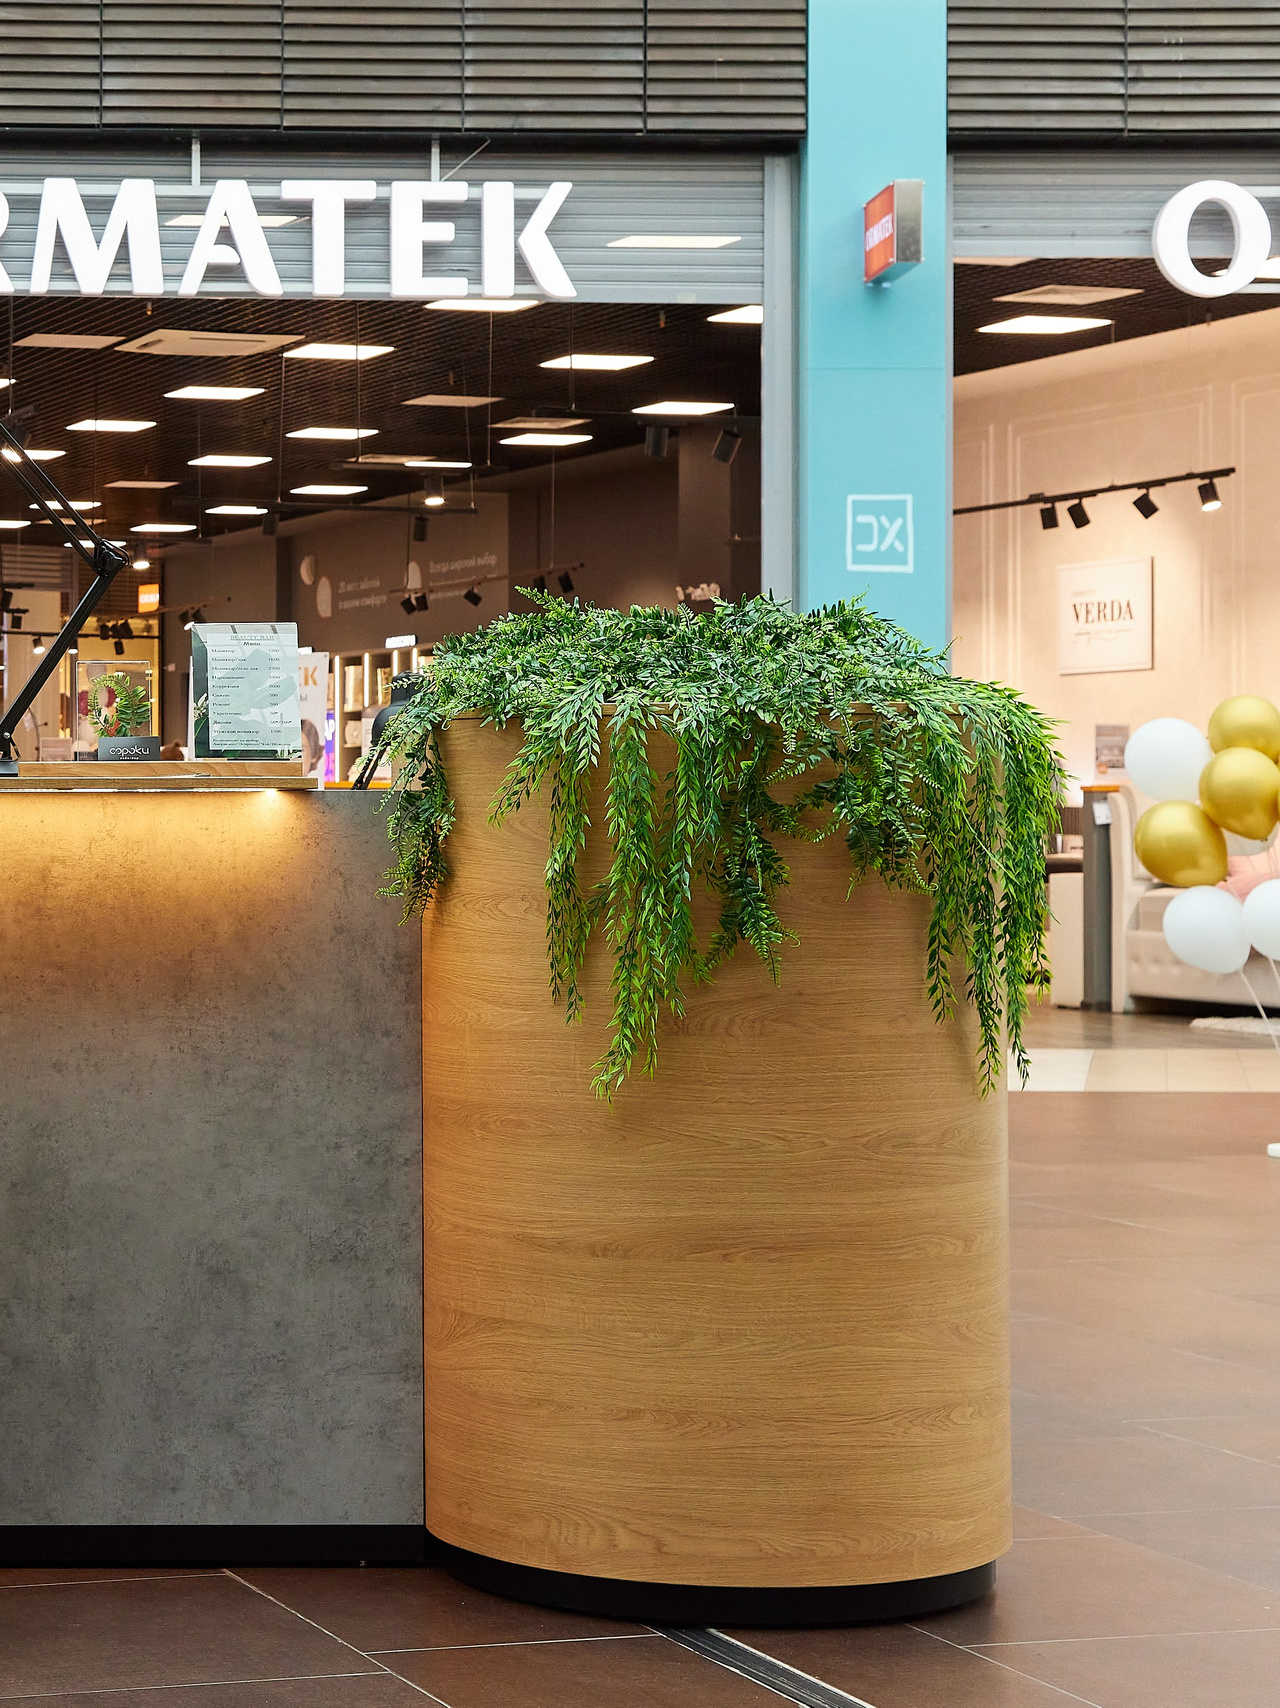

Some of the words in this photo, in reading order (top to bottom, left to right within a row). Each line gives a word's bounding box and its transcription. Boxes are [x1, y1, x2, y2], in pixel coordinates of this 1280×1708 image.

[865, 212, 894, 252] ORMATEK
[1152, 179, 1271, 298] O
[1072, 598, 1134, 625] VERDA
